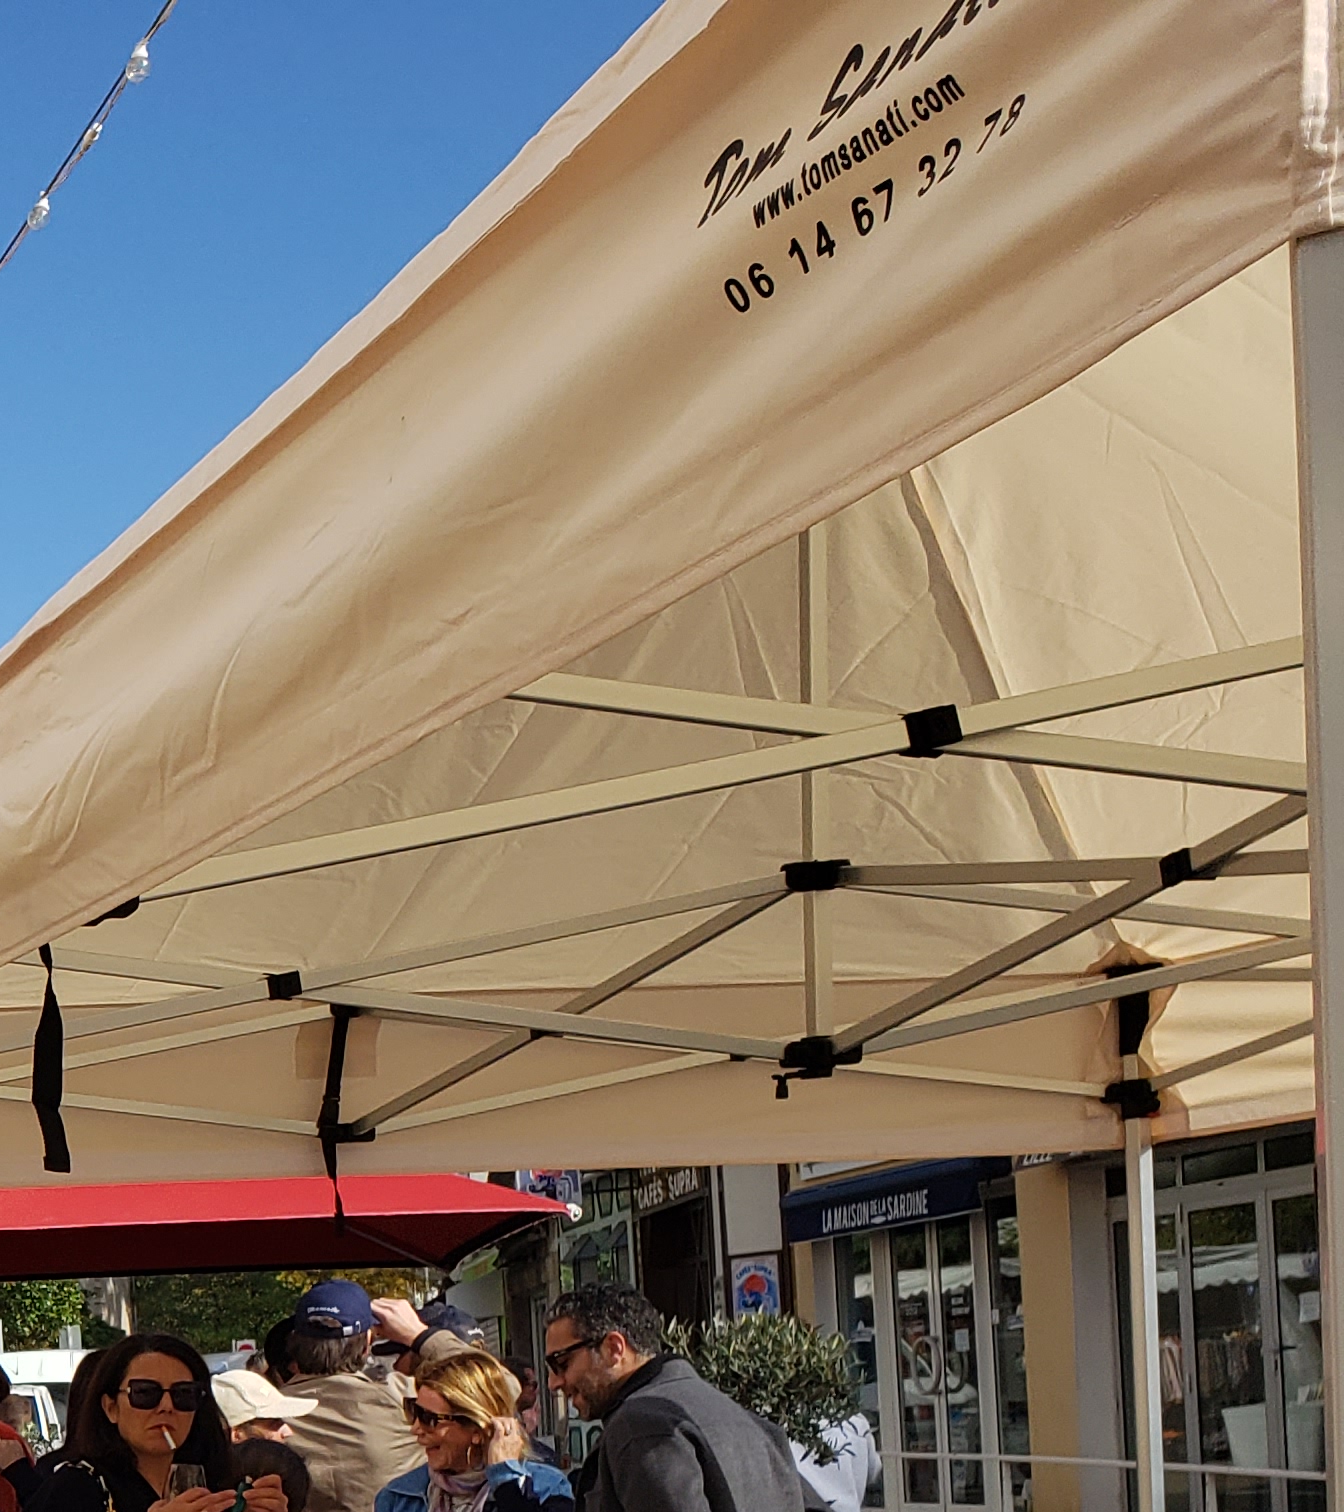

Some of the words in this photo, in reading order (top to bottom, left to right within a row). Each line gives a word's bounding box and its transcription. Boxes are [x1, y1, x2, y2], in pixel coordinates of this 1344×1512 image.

[697, 139, 792, 229] Tom
[723, 262, 775, 313] 06
[787, 220, 837, 275] 14
[850, 177, 894, 237] 67
[917, 137, 962, 199] 32
[976, 93, 1026, 155] 78
[753, 74, 966, 229] www.tomsanati.com
[822, 1207, 832, 1234] LA
[833, 1201, 869, 1230] MAISON
[870, 1199, 877, 1216] DE
[887, 1188, 929, 1221] SARDINE
